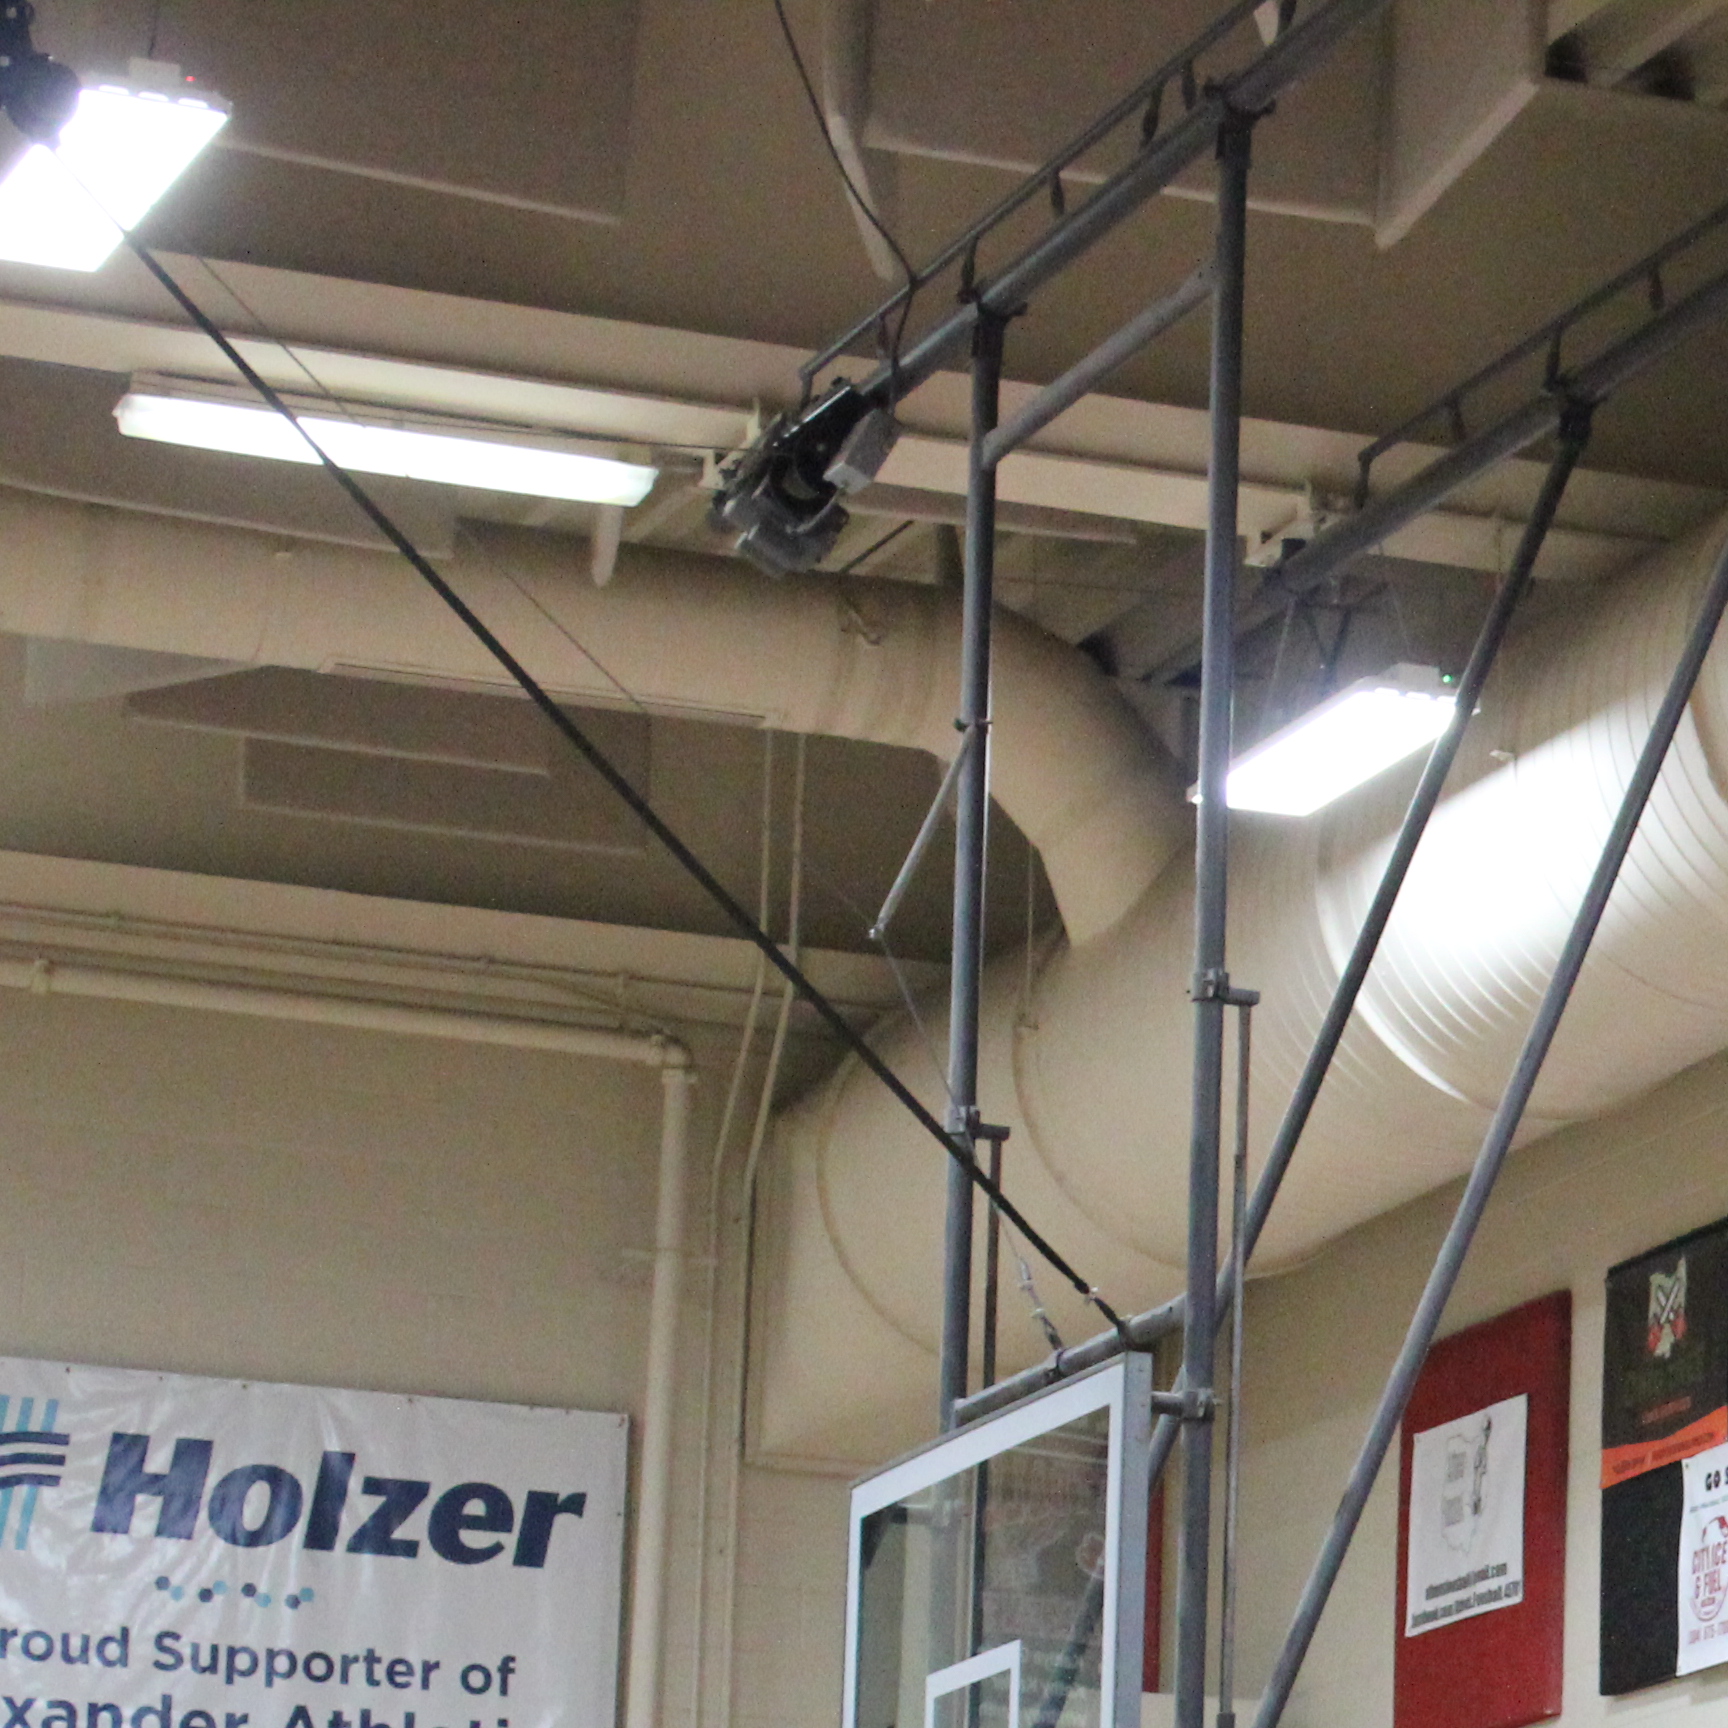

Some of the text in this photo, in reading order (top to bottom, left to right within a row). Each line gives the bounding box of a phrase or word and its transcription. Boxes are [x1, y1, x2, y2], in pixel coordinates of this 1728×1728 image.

[90, 1432, 587, 1568] Holzer
[1705, 1472, 1721, 1491] GO
[1703, 1567, 1722, 1596] FUEL
[153, 1630, 439, 1692] Supporter
[460, 1655, 516, 1697] of
